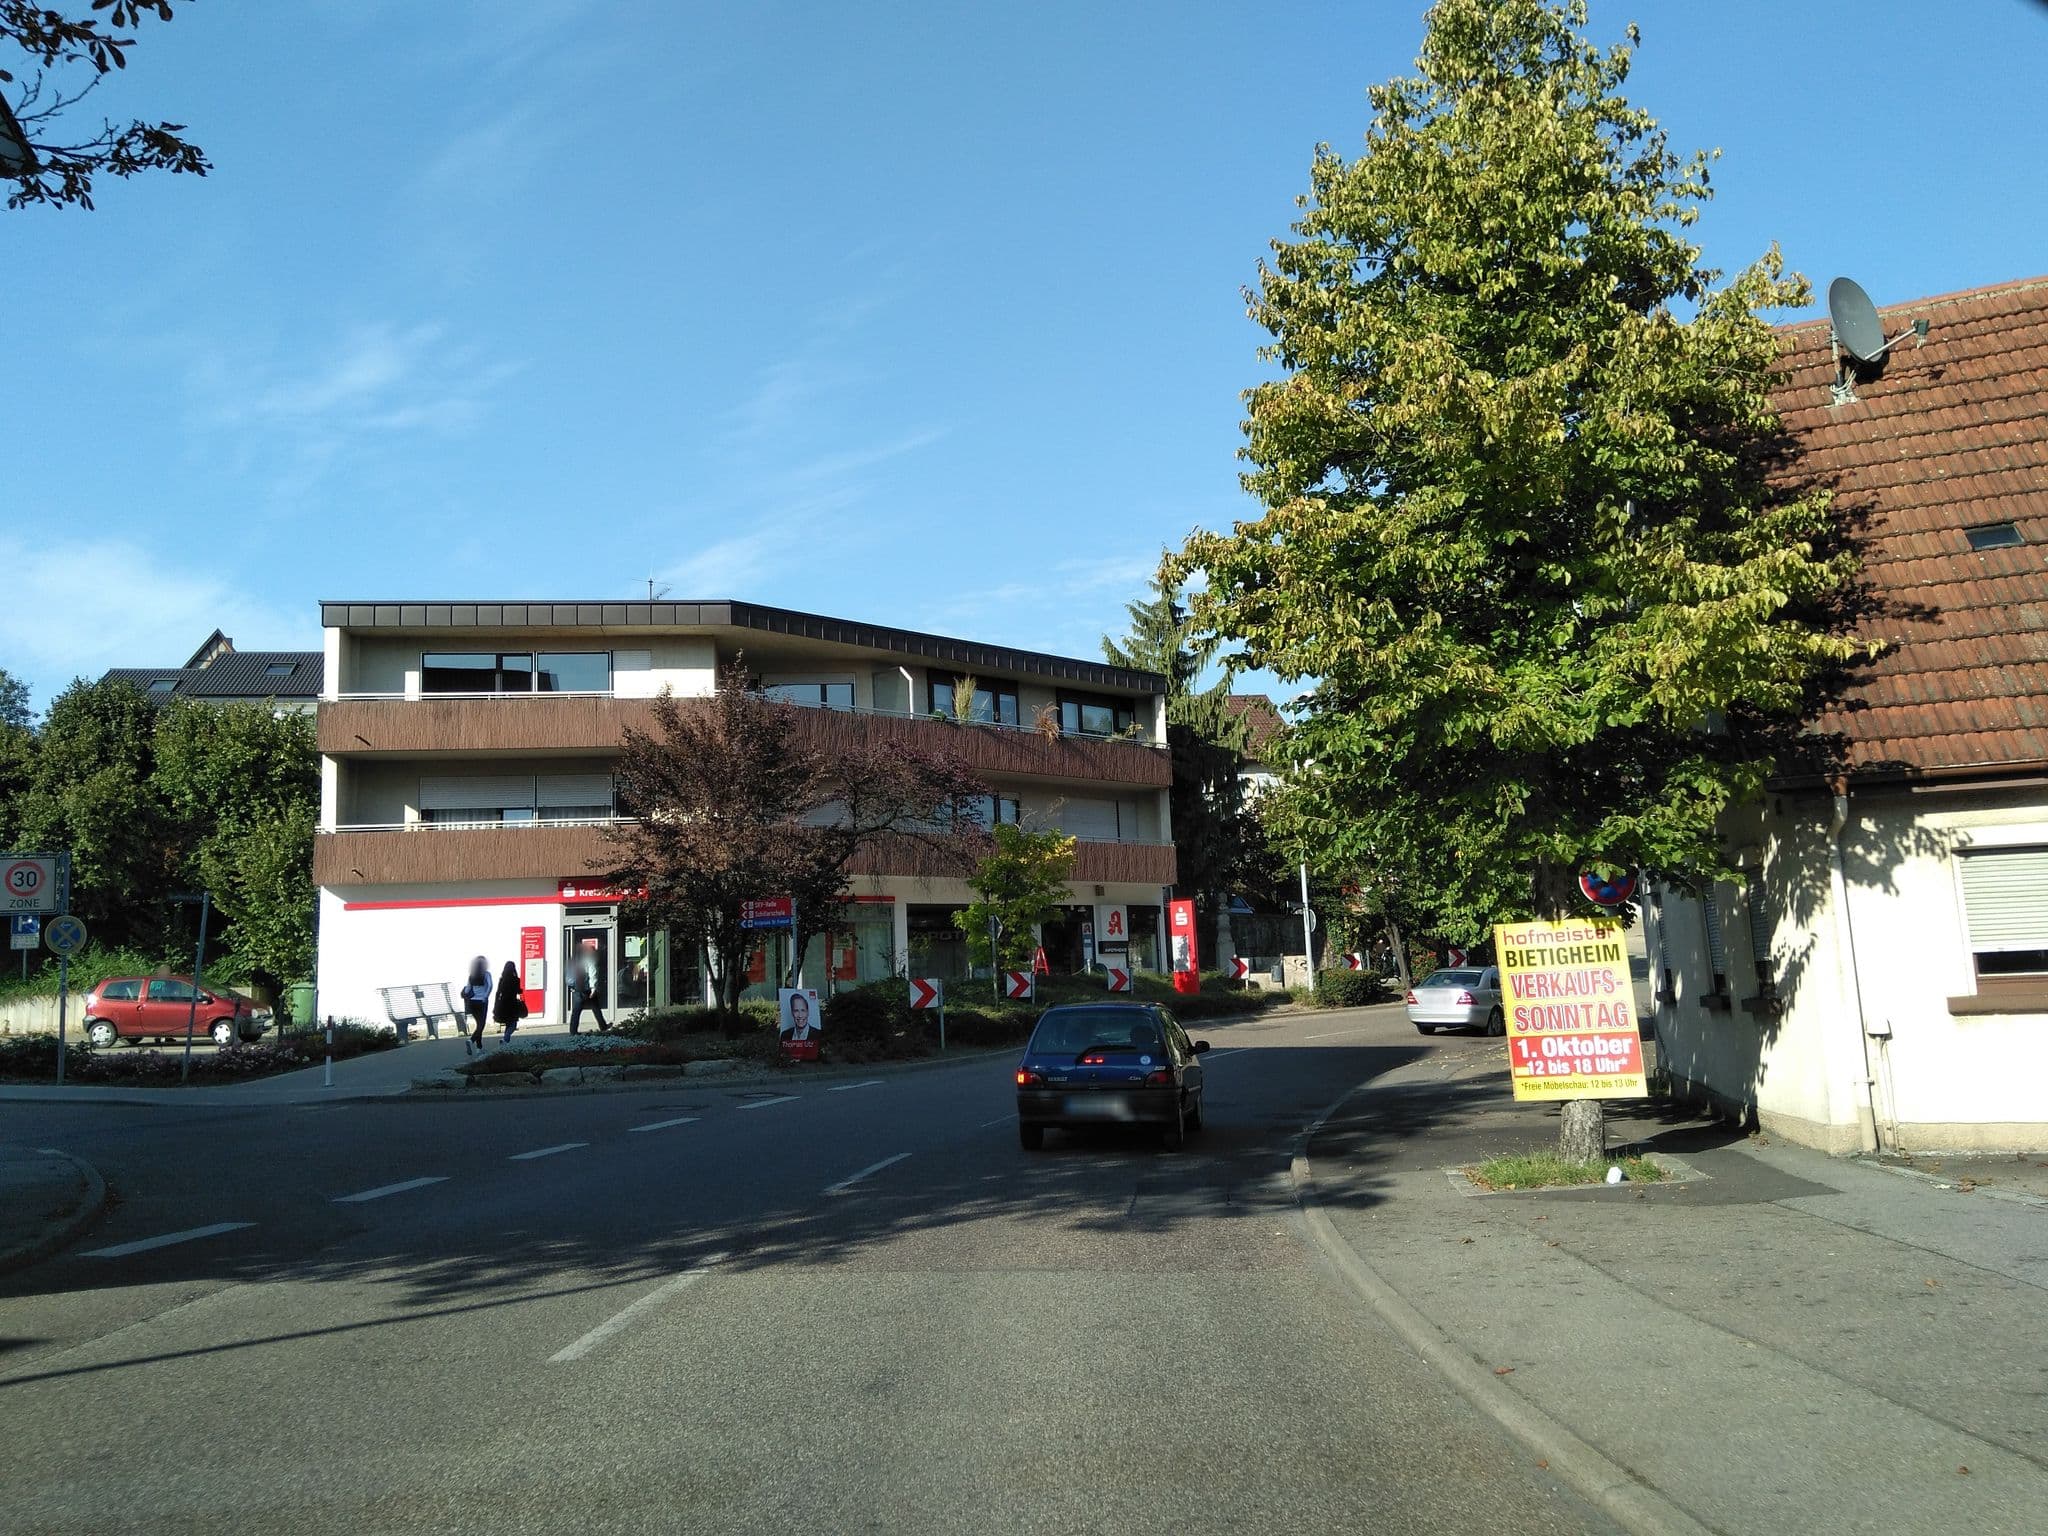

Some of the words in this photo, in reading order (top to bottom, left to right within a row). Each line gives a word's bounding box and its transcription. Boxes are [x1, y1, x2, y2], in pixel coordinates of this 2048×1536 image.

[14, 871, 37, 887] 30
[9, 899, 40, 908] ZONE
[1503, 927, 1615, 945] hofmeister
[1505, 944, 1620, 968] BIETIGHEIM
[1510, 968, 1624, 999] VERKAUFS-
[1514, 1002, 1630, 1033] SONNTAG
[1517, 1039, 1538, 1058] 1.
[1541, 1035, 1633, 1057] Oktober
[1527, 1060, 1545, 1075] 12
[1548, 1059, 1570, 1073] bis
[1573, 1058, 1592, 1073] 18
[1543, 1079, 1589, 1090] Möbelschau:
[1601, 1079, 1612, 1087] bis
[1625, 1077, 1638, 1087] Uhr
